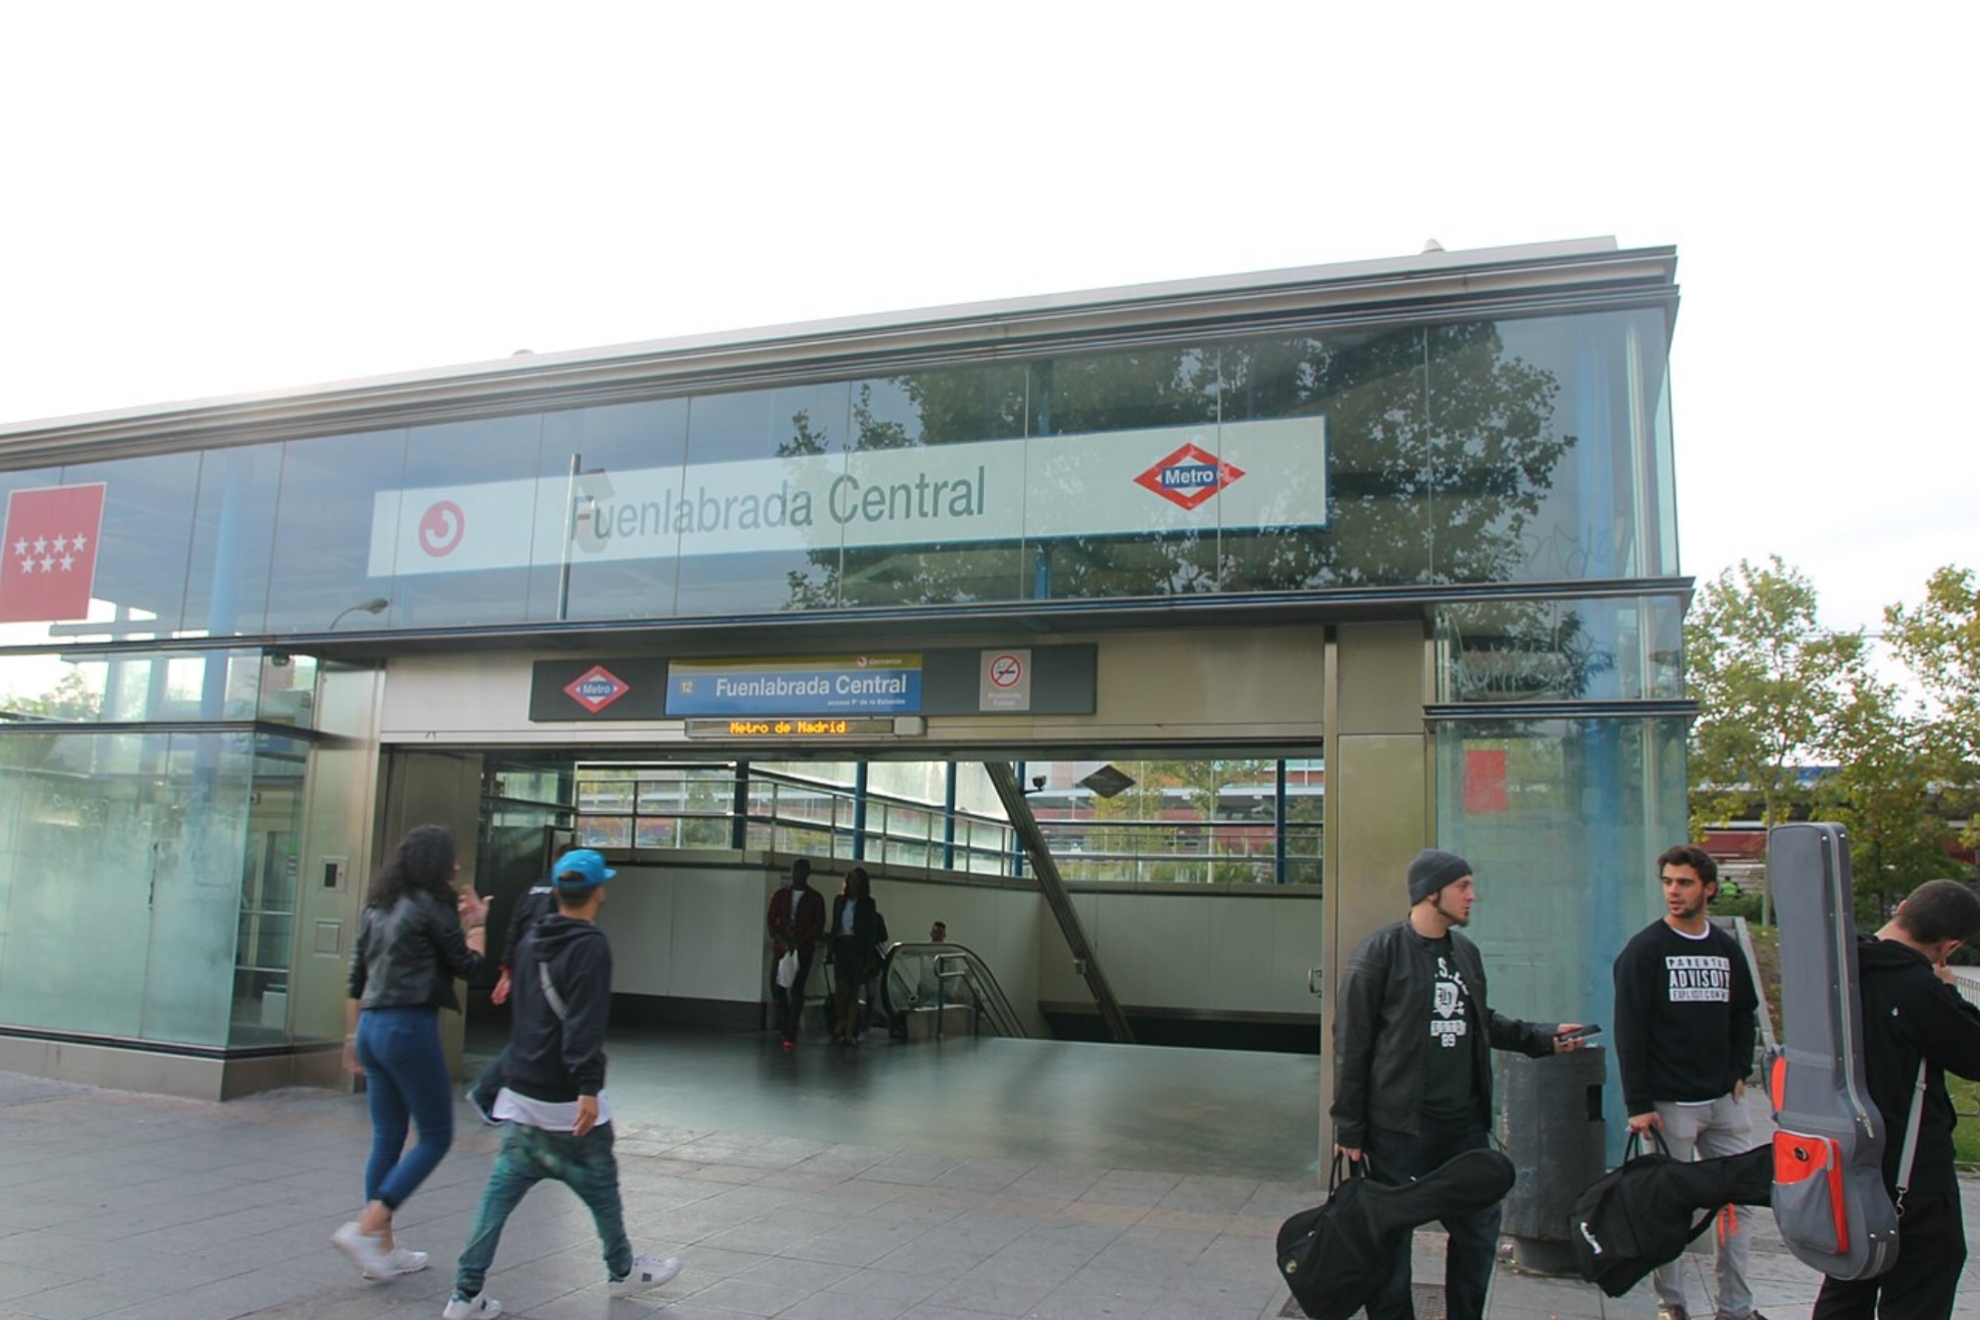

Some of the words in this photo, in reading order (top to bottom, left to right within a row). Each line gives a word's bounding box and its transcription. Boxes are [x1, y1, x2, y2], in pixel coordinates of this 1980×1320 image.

[1165, 468, 1214, 485] Metro
[571, 479, 813, 541] Fuenlabrada
[828, 465, 985, 524] Central
[582, 683, 611, 695] Metro
[681, 681, 694, 694] 12
[716, 675, 829, 697] Fuenlabrada
[836, 674, 907, 695] Central
[729, 721, 769, 734] Metro
[775, 721, 791, 734] de
[797, 721, 846, 734] Madrid
